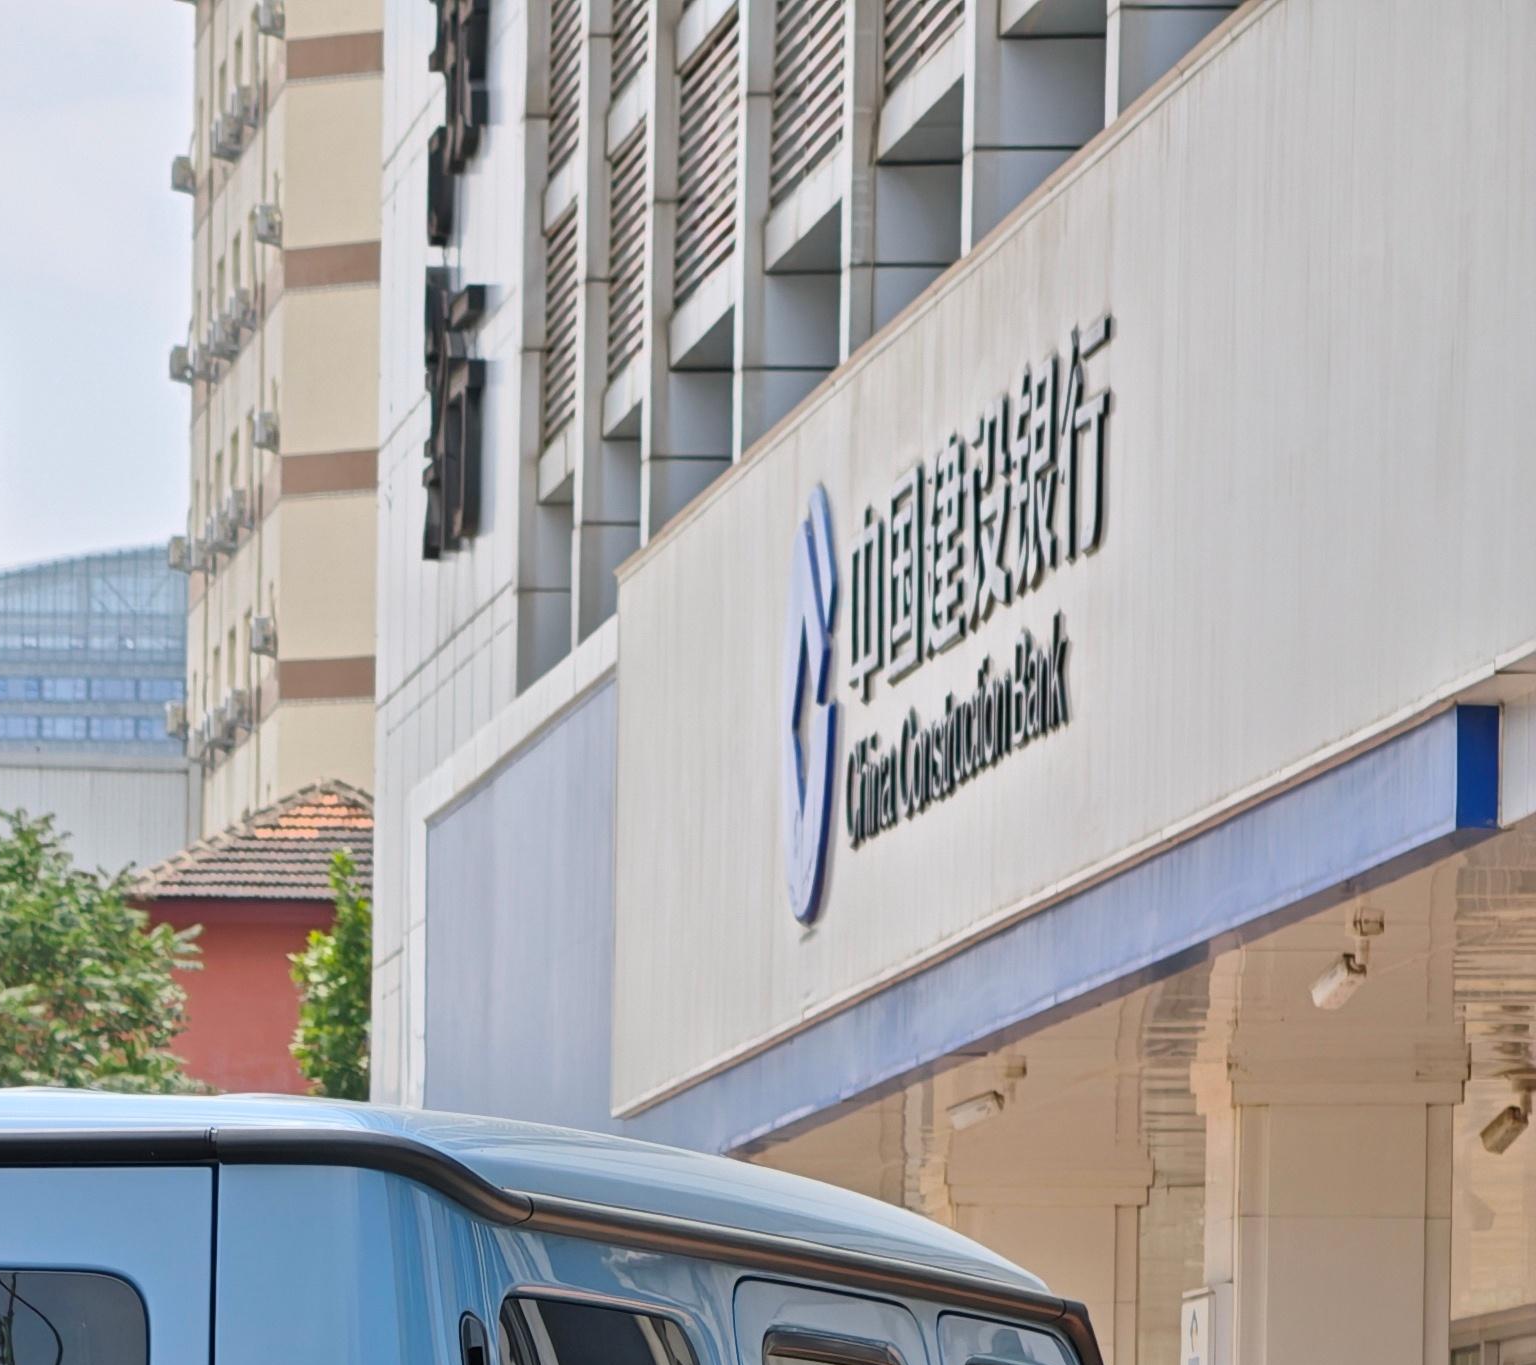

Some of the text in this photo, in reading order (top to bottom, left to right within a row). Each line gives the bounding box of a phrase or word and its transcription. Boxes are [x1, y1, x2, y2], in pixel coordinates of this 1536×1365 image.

[848, 312, 1113, 704] 中国建设银行
[846, 610, 1071, 851] China Construction Bank
